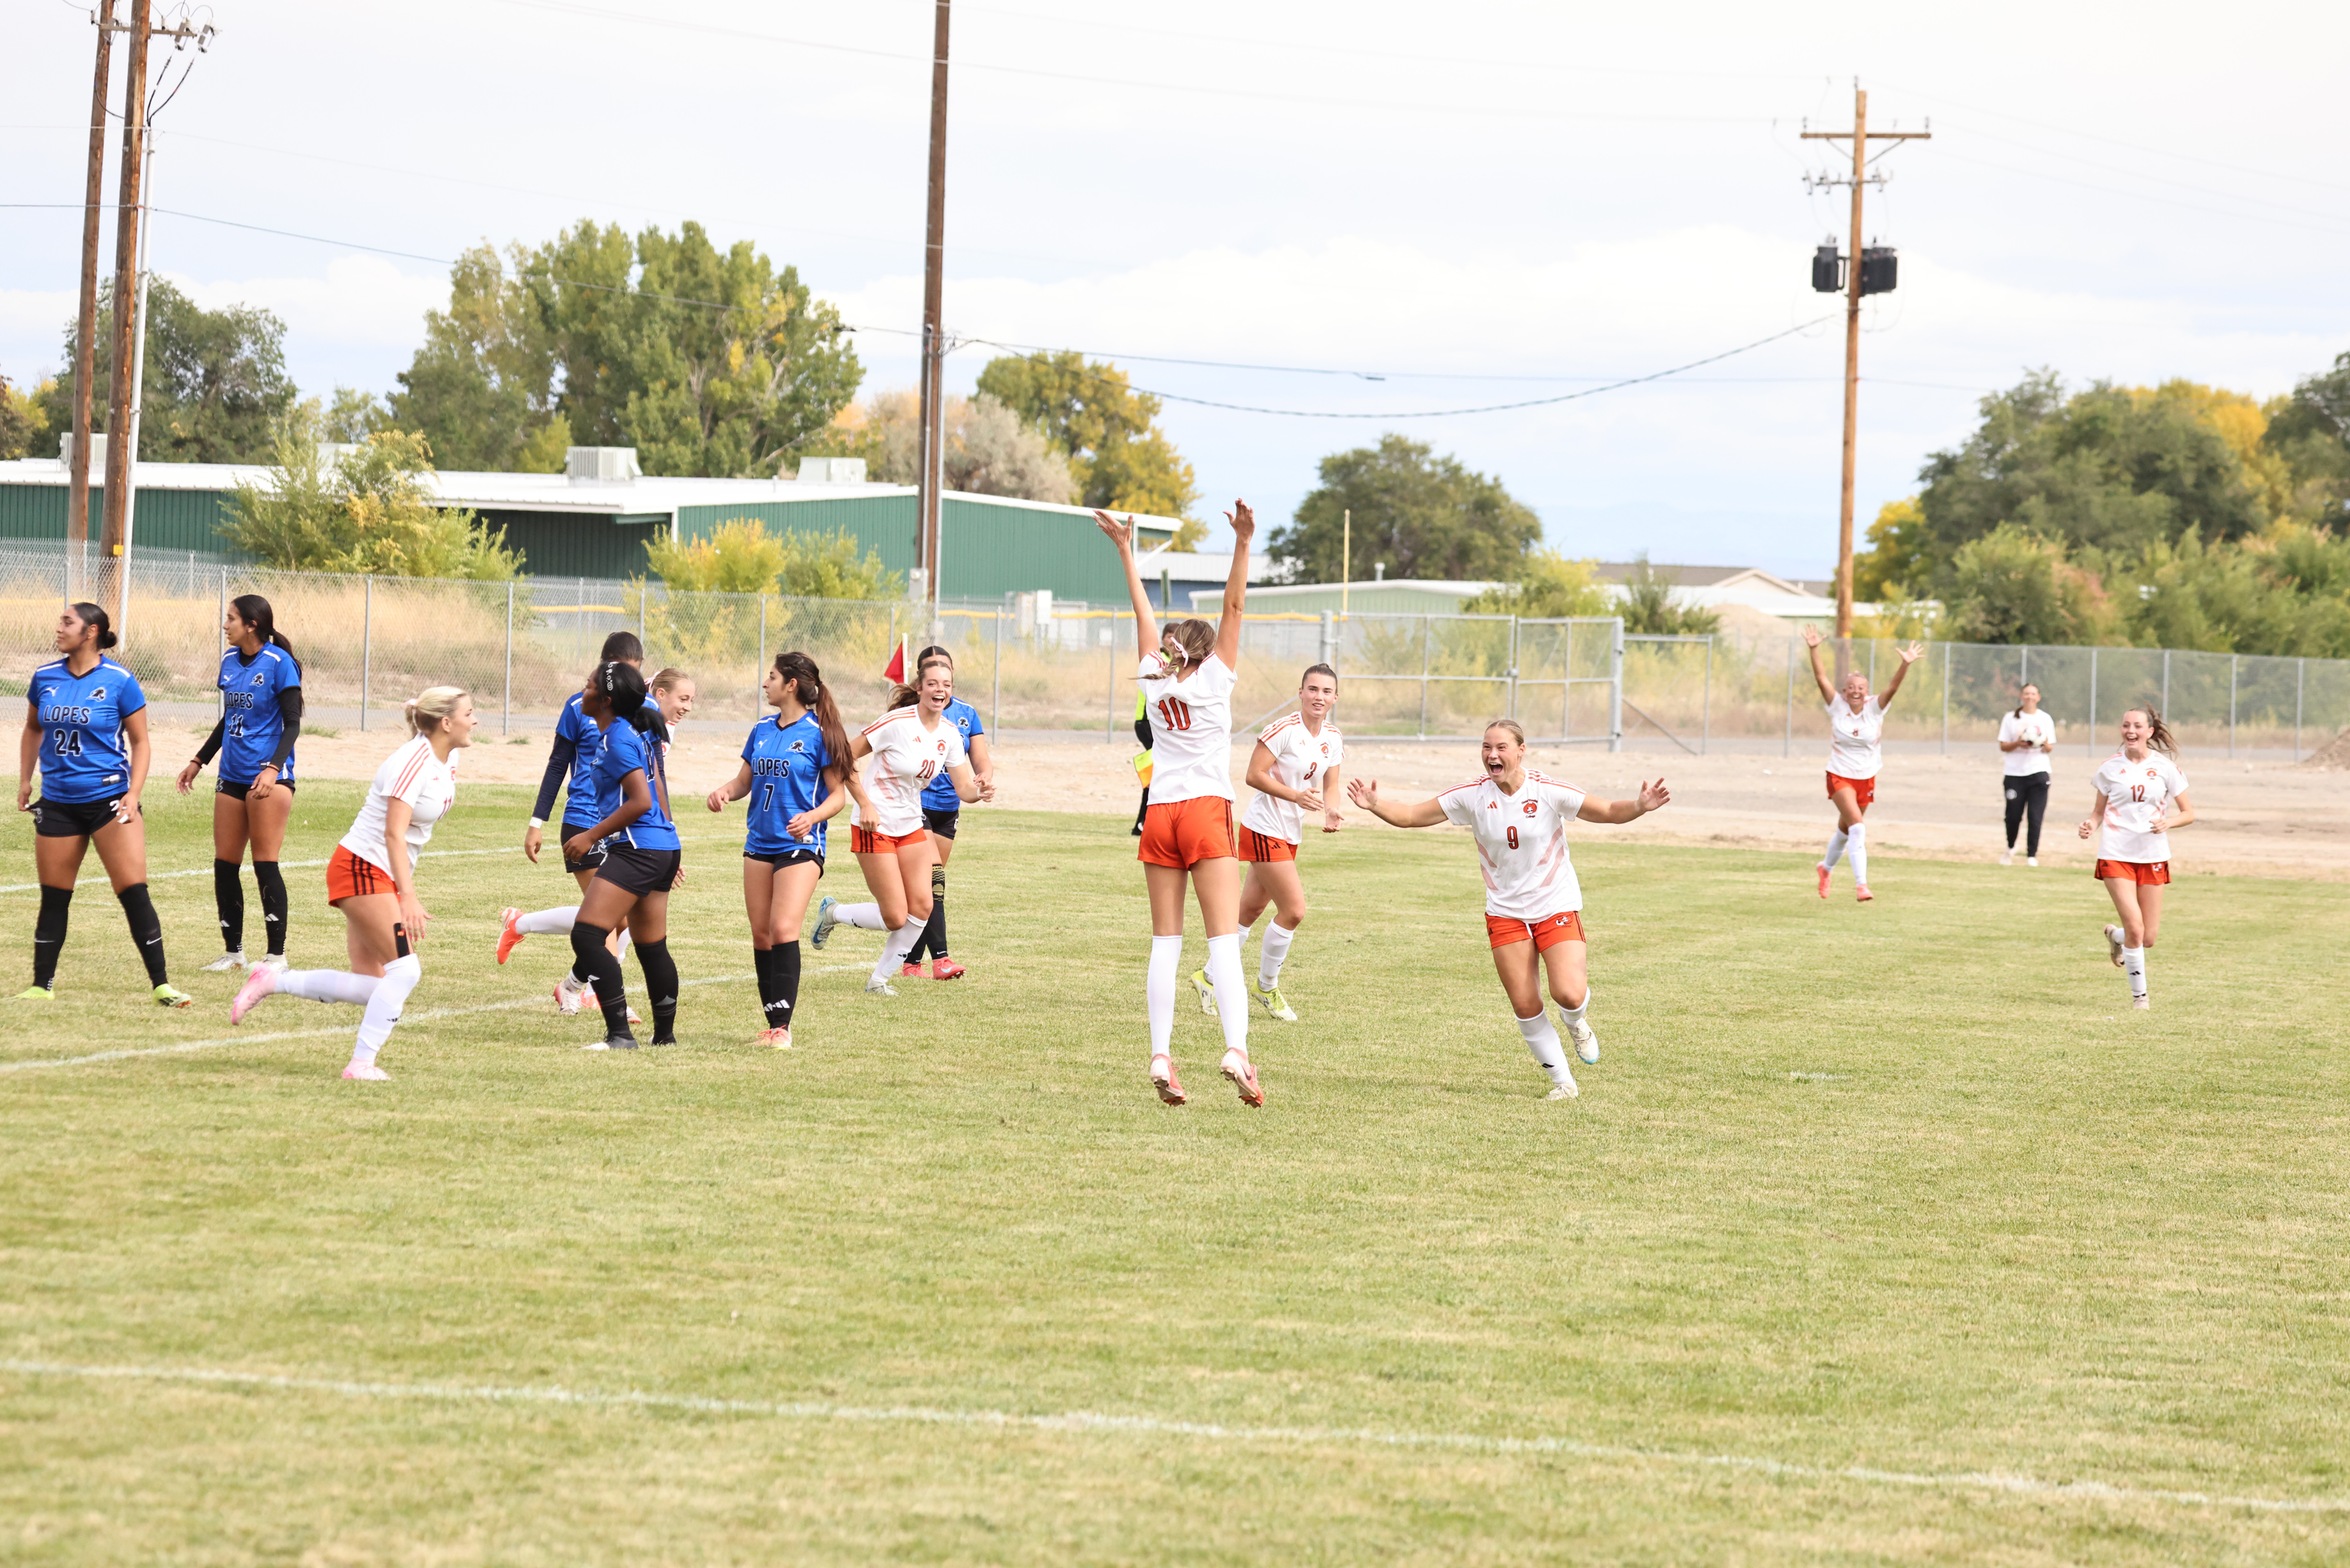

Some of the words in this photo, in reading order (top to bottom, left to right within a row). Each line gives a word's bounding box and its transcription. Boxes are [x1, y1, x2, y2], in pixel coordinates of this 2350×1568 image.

[43, 705, 90, 725] LOPES
[1158, 696, 1191, 731] 10
[229, 714, 243, 737] 11
[53, 728, 83, 756] 24
[752, 757, 790, 778] LOPES
[915, 759, 935, 779] 20
[1303, 761, 1318, 780] 3
[763, 783, 774, 811] 7
[2130, 784, 2145, 802] 12
[1507, 825, 1519, 850] 9
